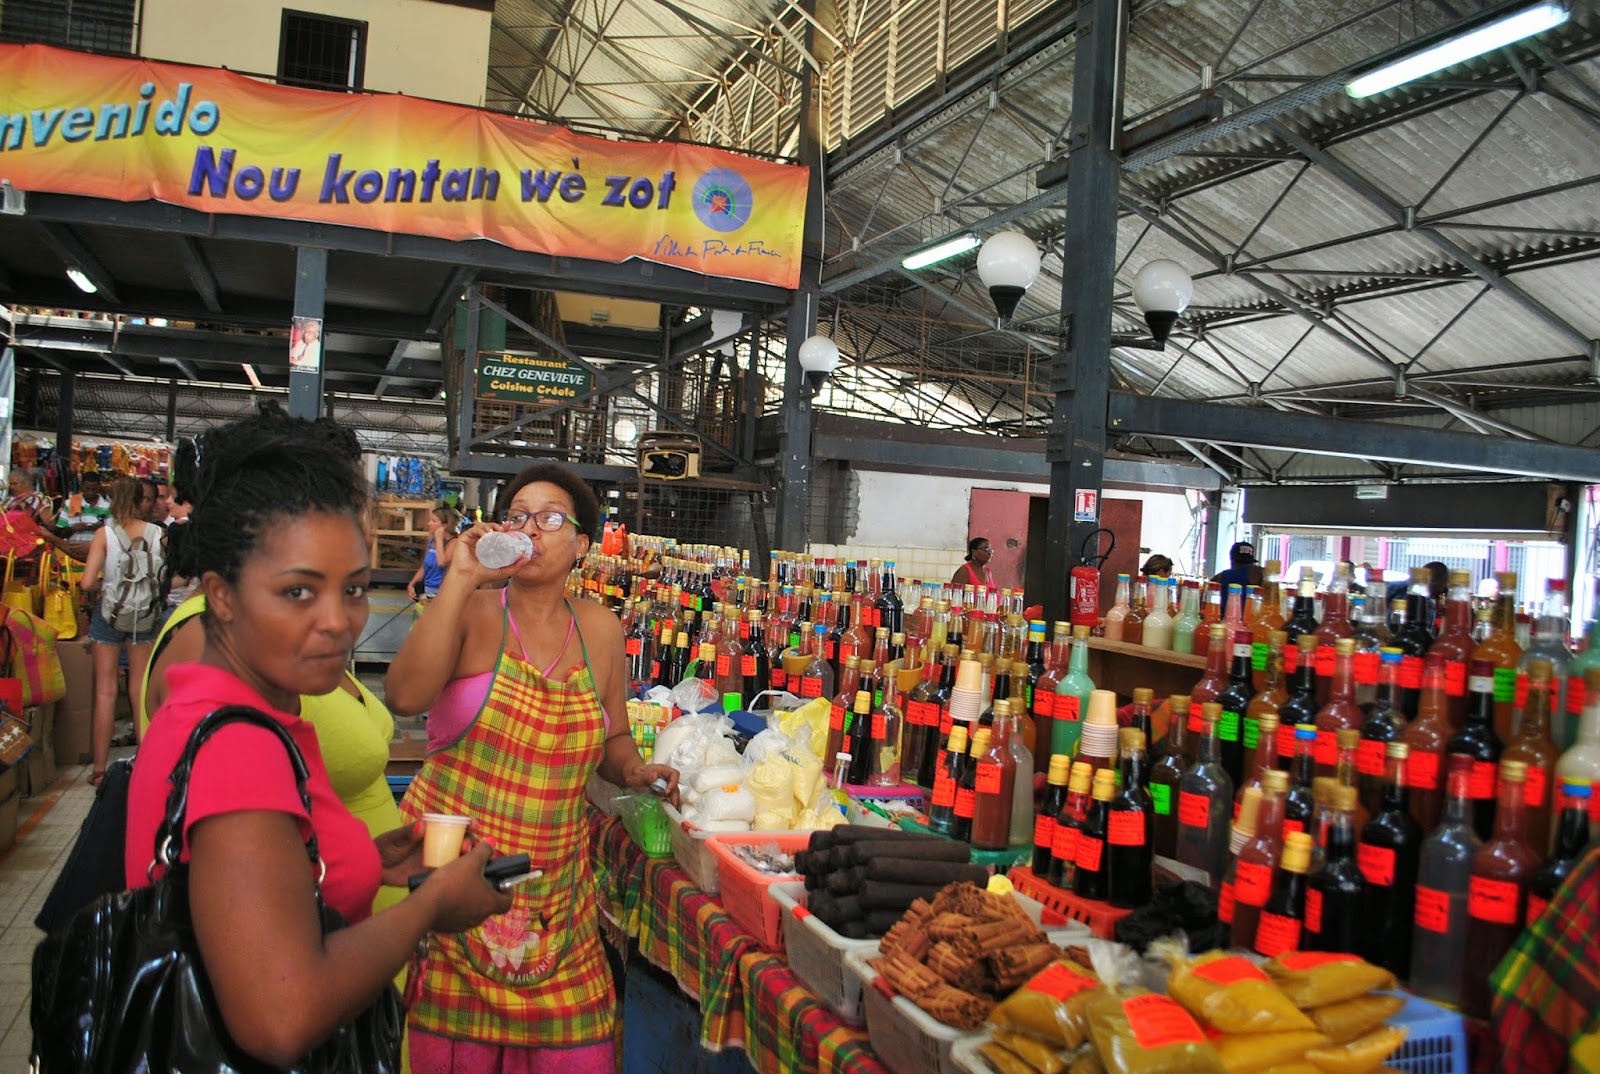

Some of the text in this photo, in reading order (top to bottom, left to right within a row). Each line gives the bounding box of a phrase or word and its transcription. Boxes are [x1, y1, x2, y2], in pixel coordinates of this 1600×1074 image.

[0, 82, 219, 152] nvenido
[188, 145, 676, 210] Nou kontan wè zot
[502, 354, 568, 369] Restaurant
[483, 365, 585, 385] CHEZ GENEVIEVE
[490, 380, 576, 397] Cuisine Créole
